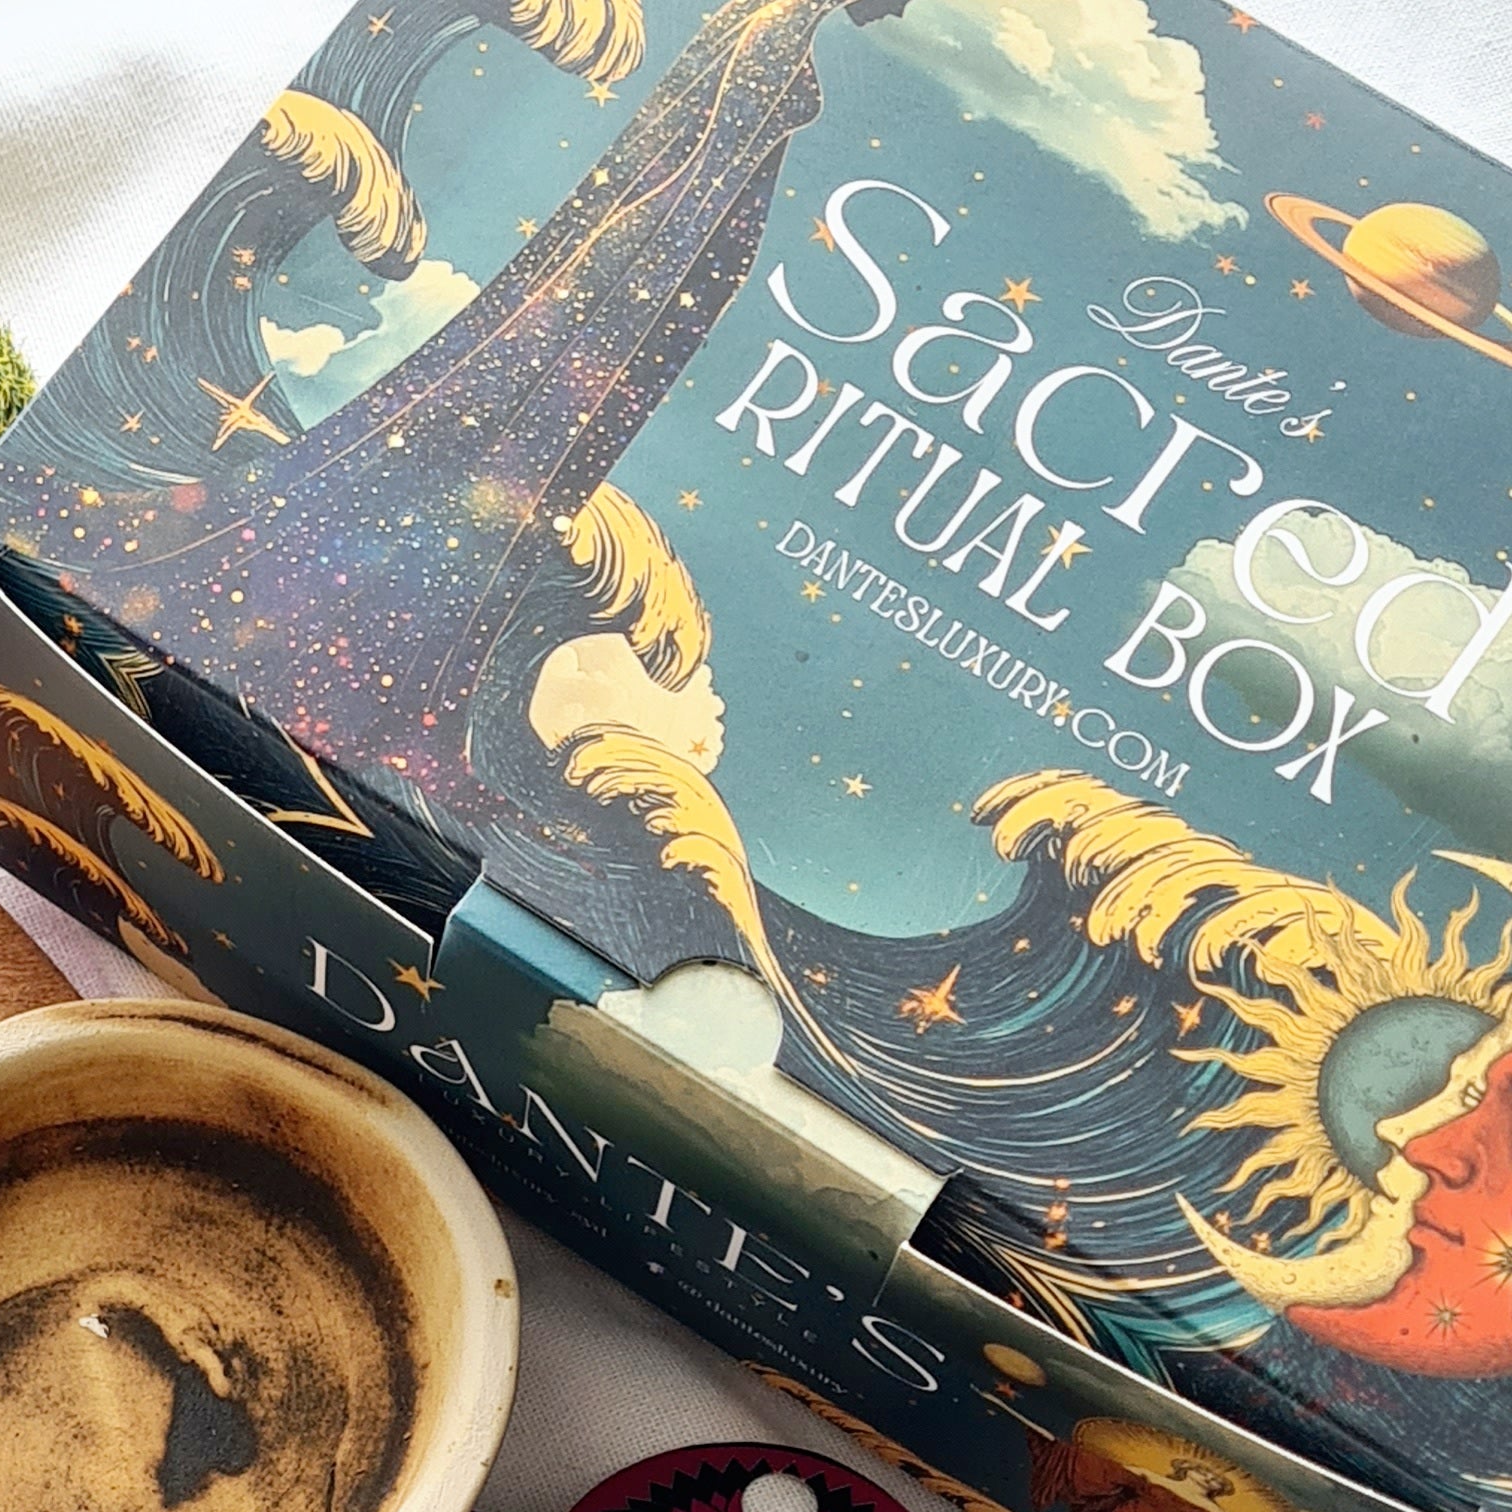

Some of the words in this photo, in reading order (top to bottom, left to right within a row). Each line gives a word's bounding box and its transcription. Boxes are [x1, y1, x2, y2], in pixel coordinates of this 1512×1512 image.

[714, 339, 1087, 634] RITUAL
[1102, 581, 1390, 805] BOX
[766, 177, 1512, 724] Sacred
[1086, 275, 1347, 439] Dante's
[775, 520, 1192, 798] DANTESLUXURY.COM
[303, 936, 947, 1393] DANTE'S
